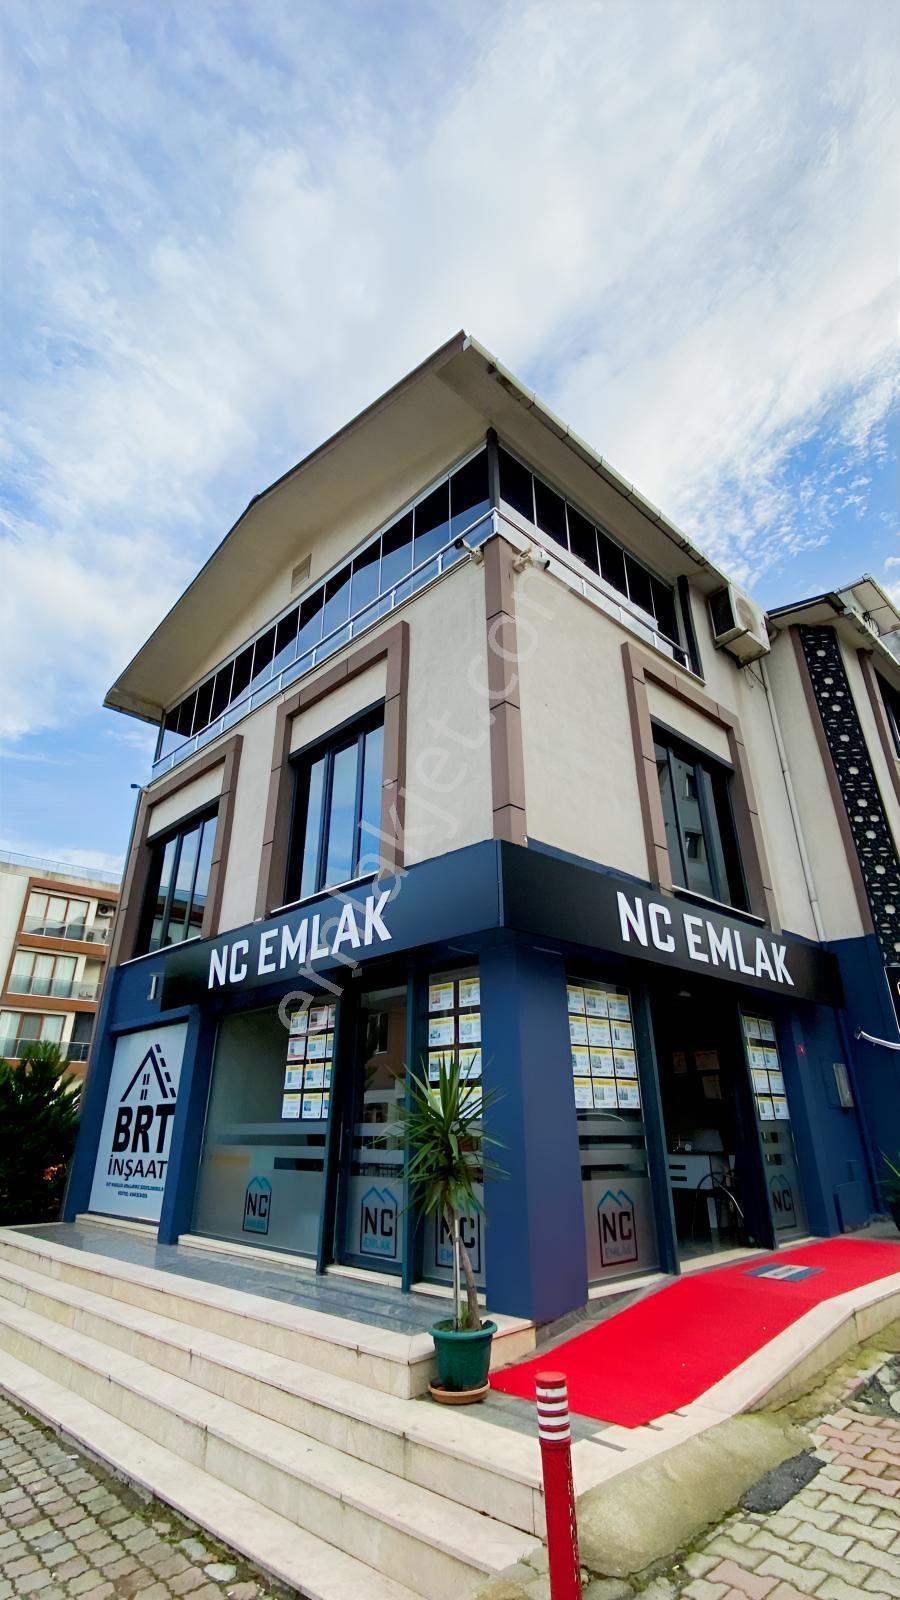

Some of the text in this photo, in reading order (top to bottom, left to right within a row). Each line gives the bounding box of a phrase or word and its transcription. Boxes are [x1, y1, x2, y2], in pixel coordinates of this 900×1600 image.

[208, 890, 392, 989] NC EMLAK
[617, 891, 794, 985] NC EMLAK
[111, 1103, 176, 1154] BRT
[107, 1154, 168, 1181] İNŞAAT
[246, 1193, 268, 1218] NC
[772, 1189, 792, 1214] NC
[364, 1207, 393, 1236] NC
[440, 1215, 475, 1248] NC
[602, 1211, 632, 1243] NC
